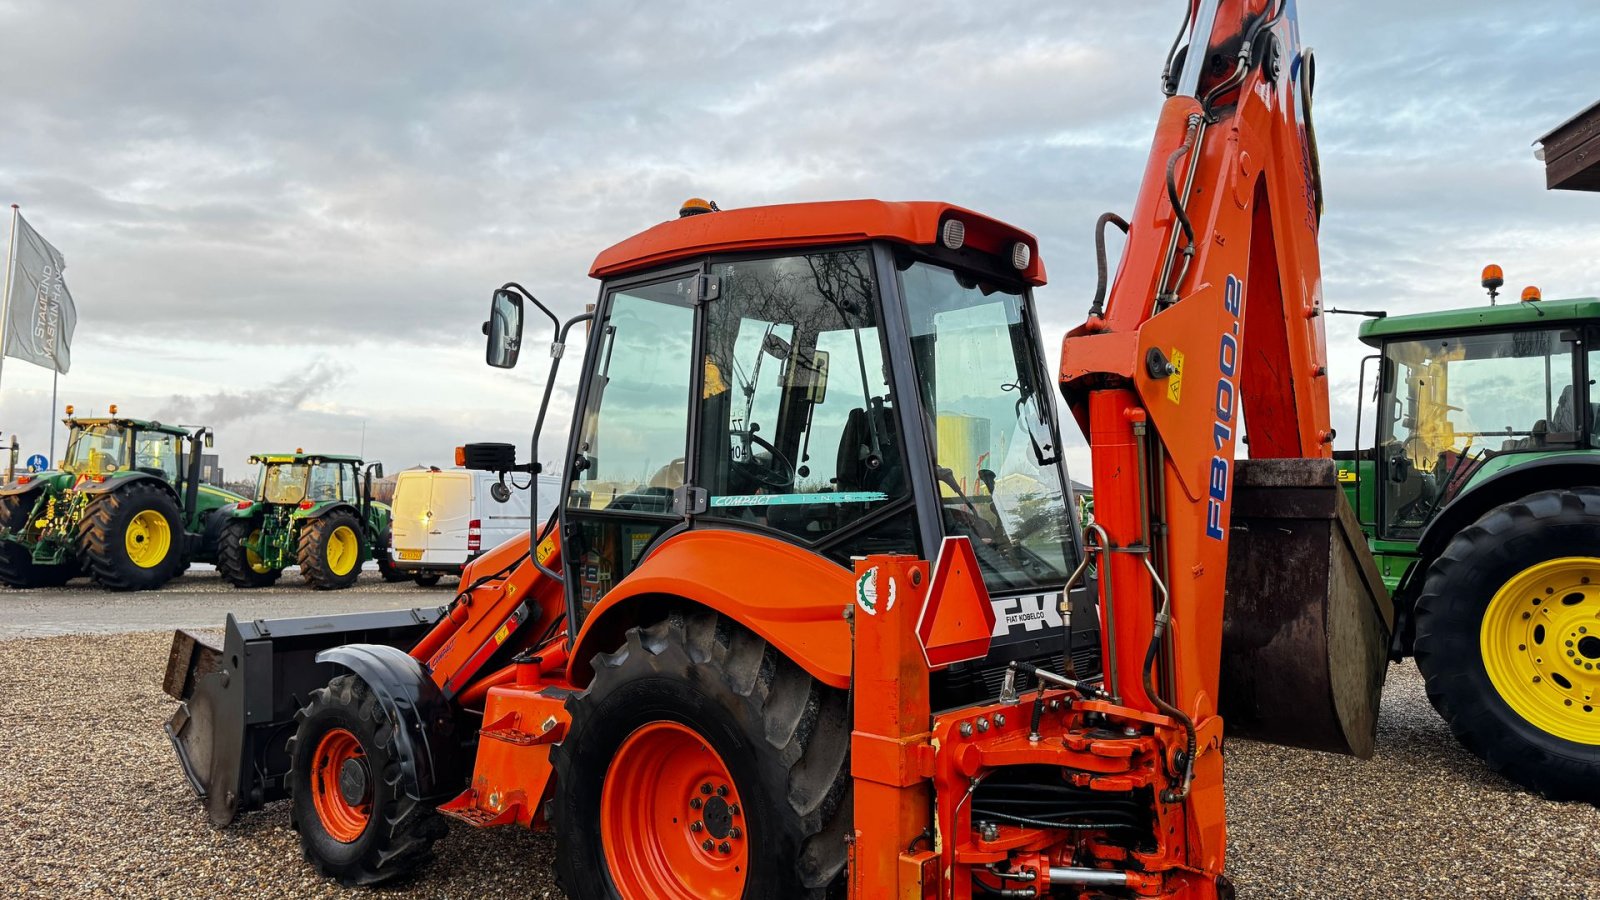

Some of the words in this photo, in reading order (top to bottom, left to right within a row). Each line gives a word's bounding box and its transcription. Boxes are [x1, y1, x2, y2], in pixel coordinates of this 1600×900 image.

[1206, 273, 1242, 541] FB100.2
[715, 495, 776, 506] COMPACT
[1006, 615, 1018, 624] FIAT
[1019, 611, 1045, 622] KOBELCO
